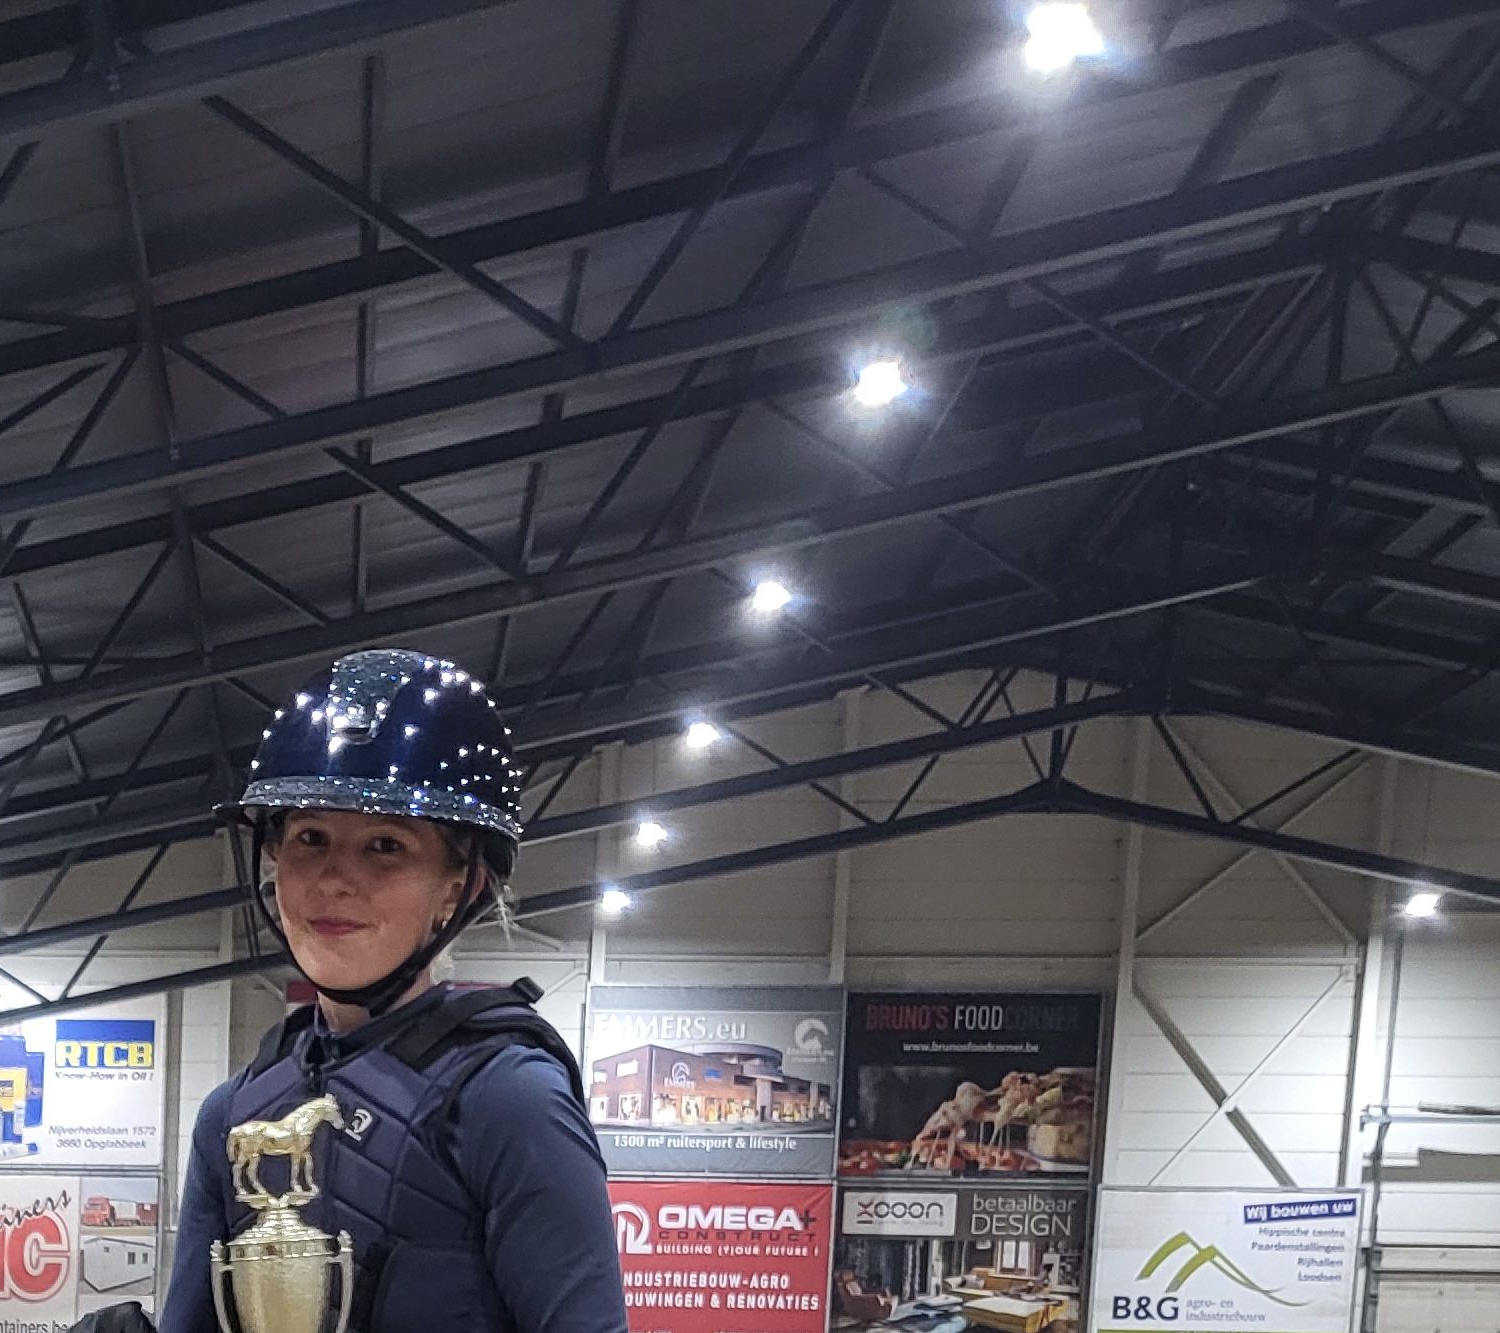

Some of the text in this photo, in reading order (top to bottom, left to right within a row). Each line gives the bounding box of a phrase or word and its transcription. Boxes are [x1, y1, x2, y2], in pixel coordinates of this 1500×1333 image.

[593, 1013, 748, 1041] EMMERS.eu
[866, 1005, 949, 1031] BRUNO'S
[55, 1041, 153, 1068] RTCB
[666, 1134, 732, 1152] ruitersport
[735, 1136, 745, 1149] &
[749, 1135, 797, 1152] lifestyle
[972, 1192, 1076, 1213] betaalbaar
[1246, 1200, 1353, 1222] Wij bouwen uw
[970, 1213, 1072, 1236] DESIGN
[658, 1230, 817, 1242] CONSTRUCT
[656, 1243, 713, 1255] BUILDING
[764, 1245, 809, 1257] FUTURE
[623, 1271, 790, 1290] NDUSTRIEBOUW-AGRO
[625, 1292, 819, 1311] OUWINGEN & RENOVATIES
[1112, 1295, 1179, 1321] B&G
